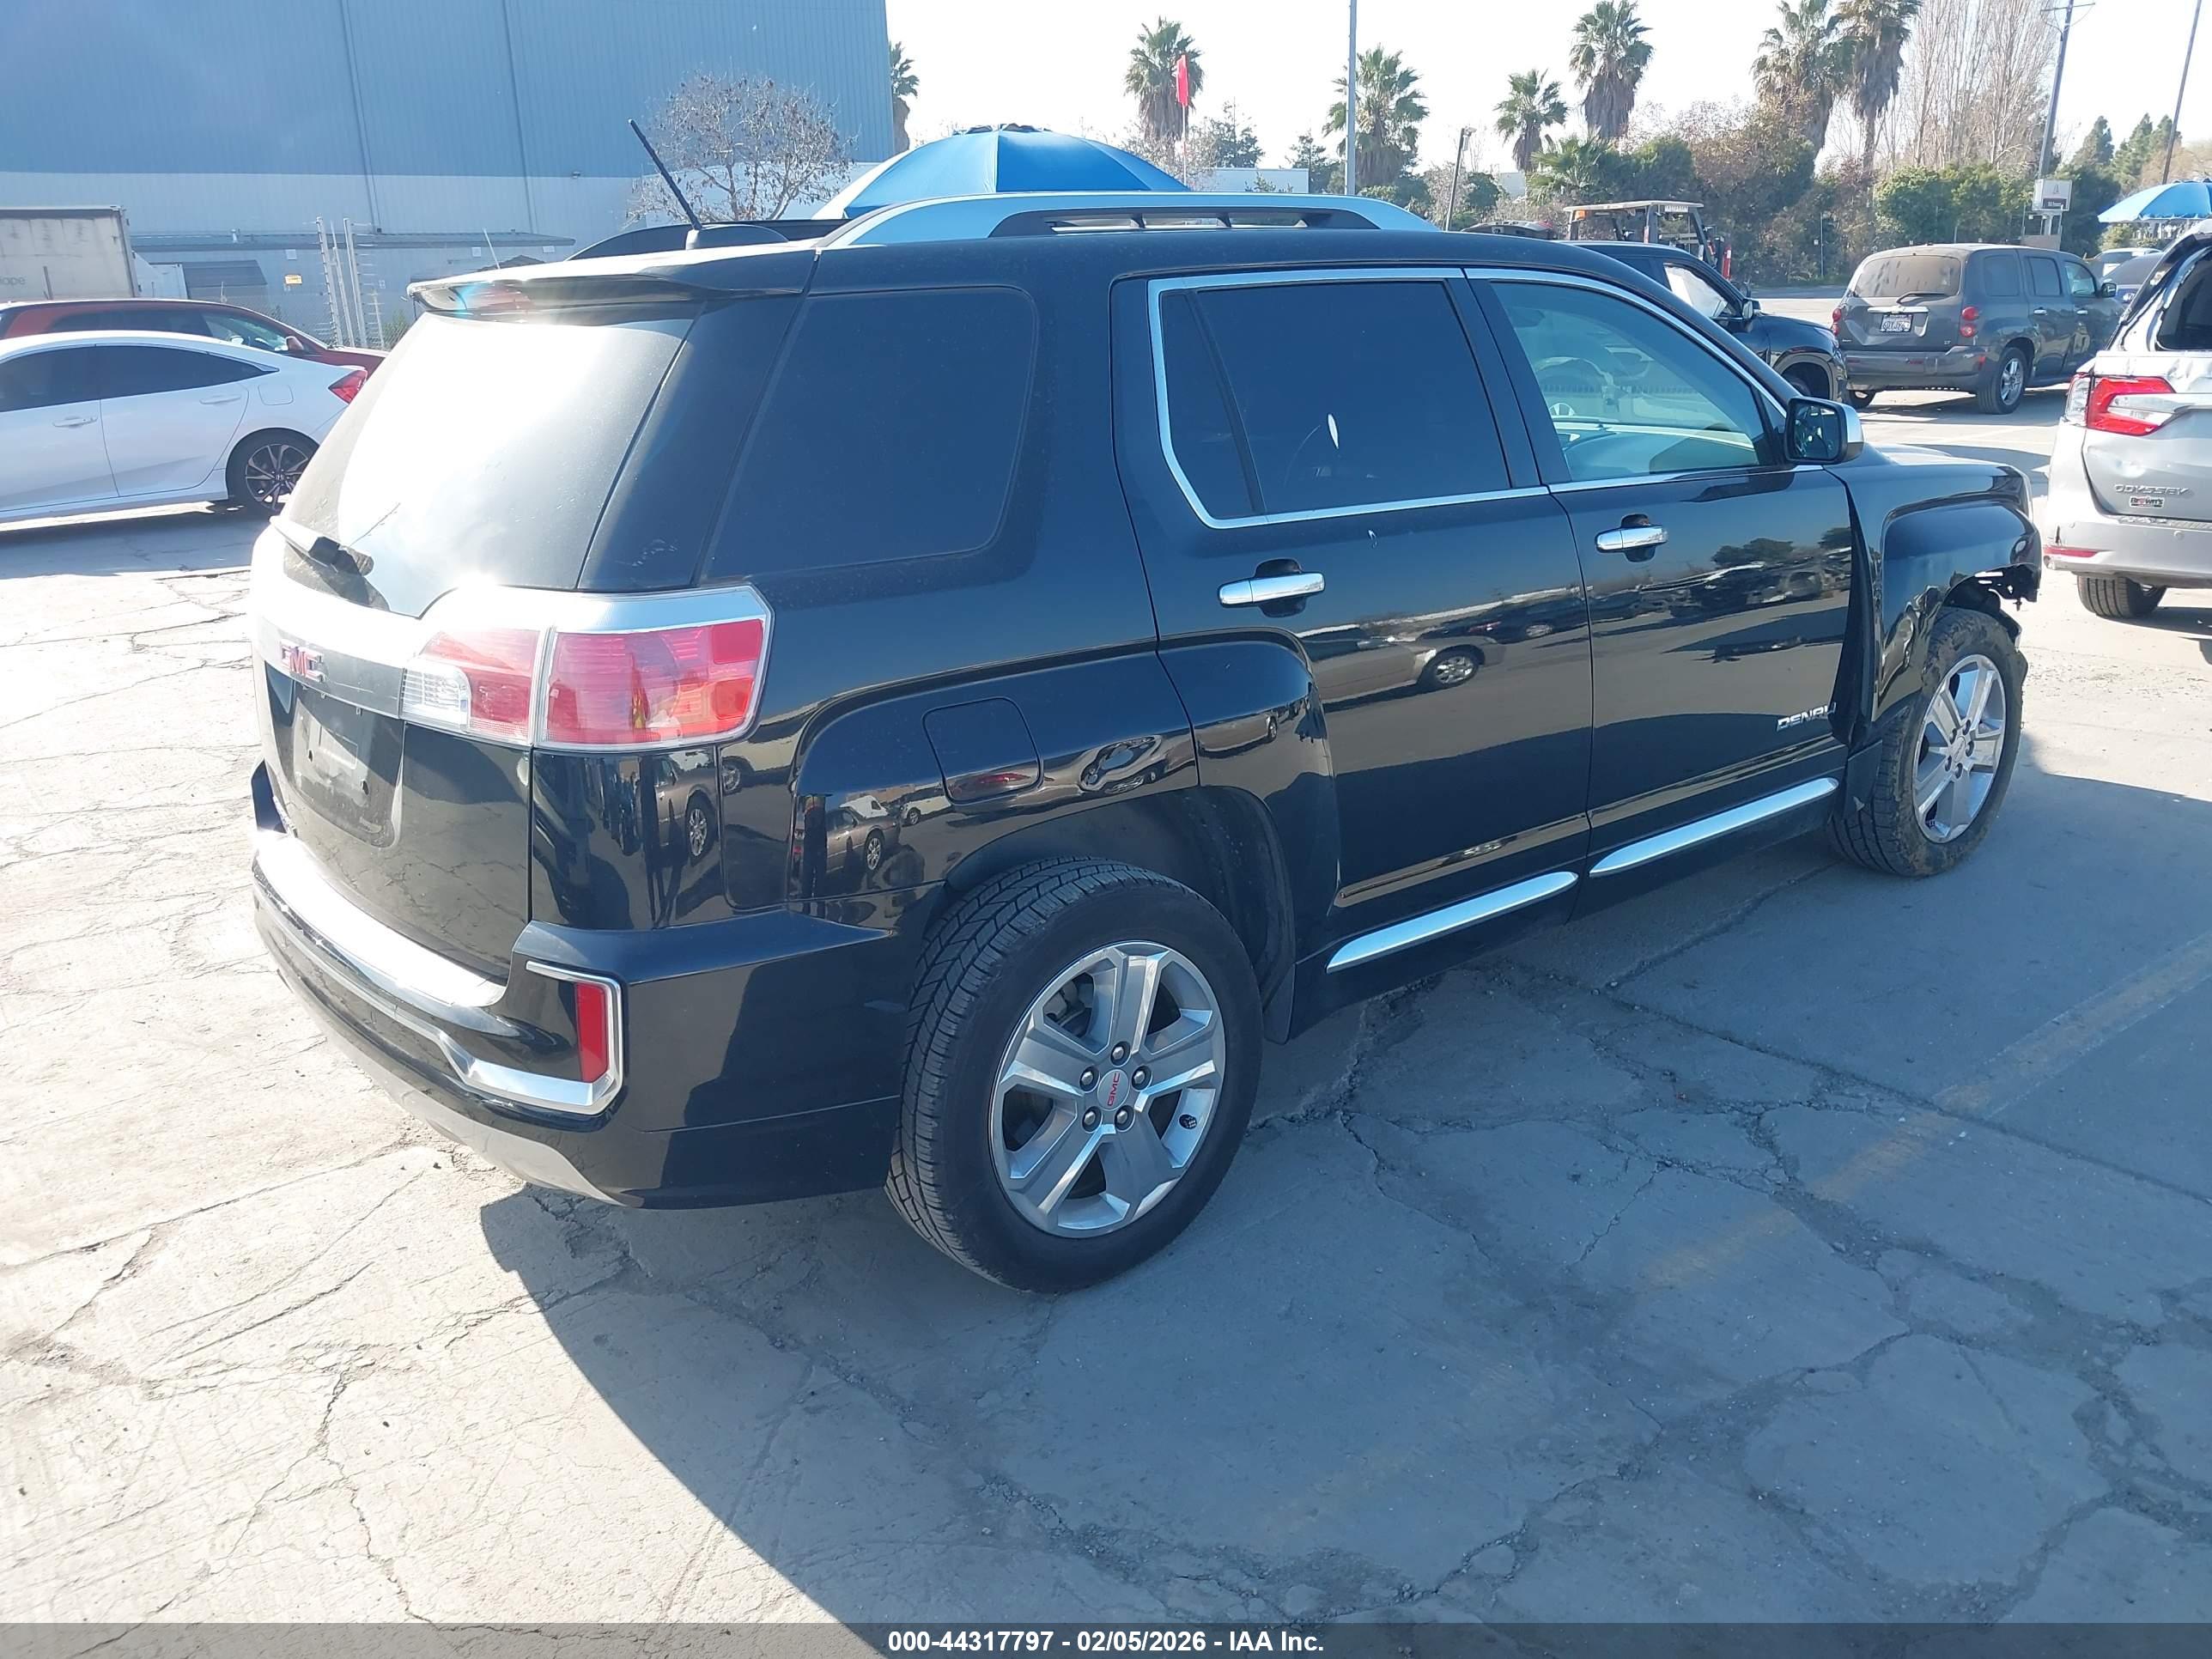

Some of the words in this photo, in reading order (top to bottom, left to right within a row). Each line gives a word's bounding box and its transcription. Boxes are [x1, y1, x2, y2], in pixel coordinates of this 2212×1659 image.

[2114, 483, 2190, 495] ODYSSEY
[281, 644, 327, 683] GMC
[1107, 1072, 1121, 1106] GMC
